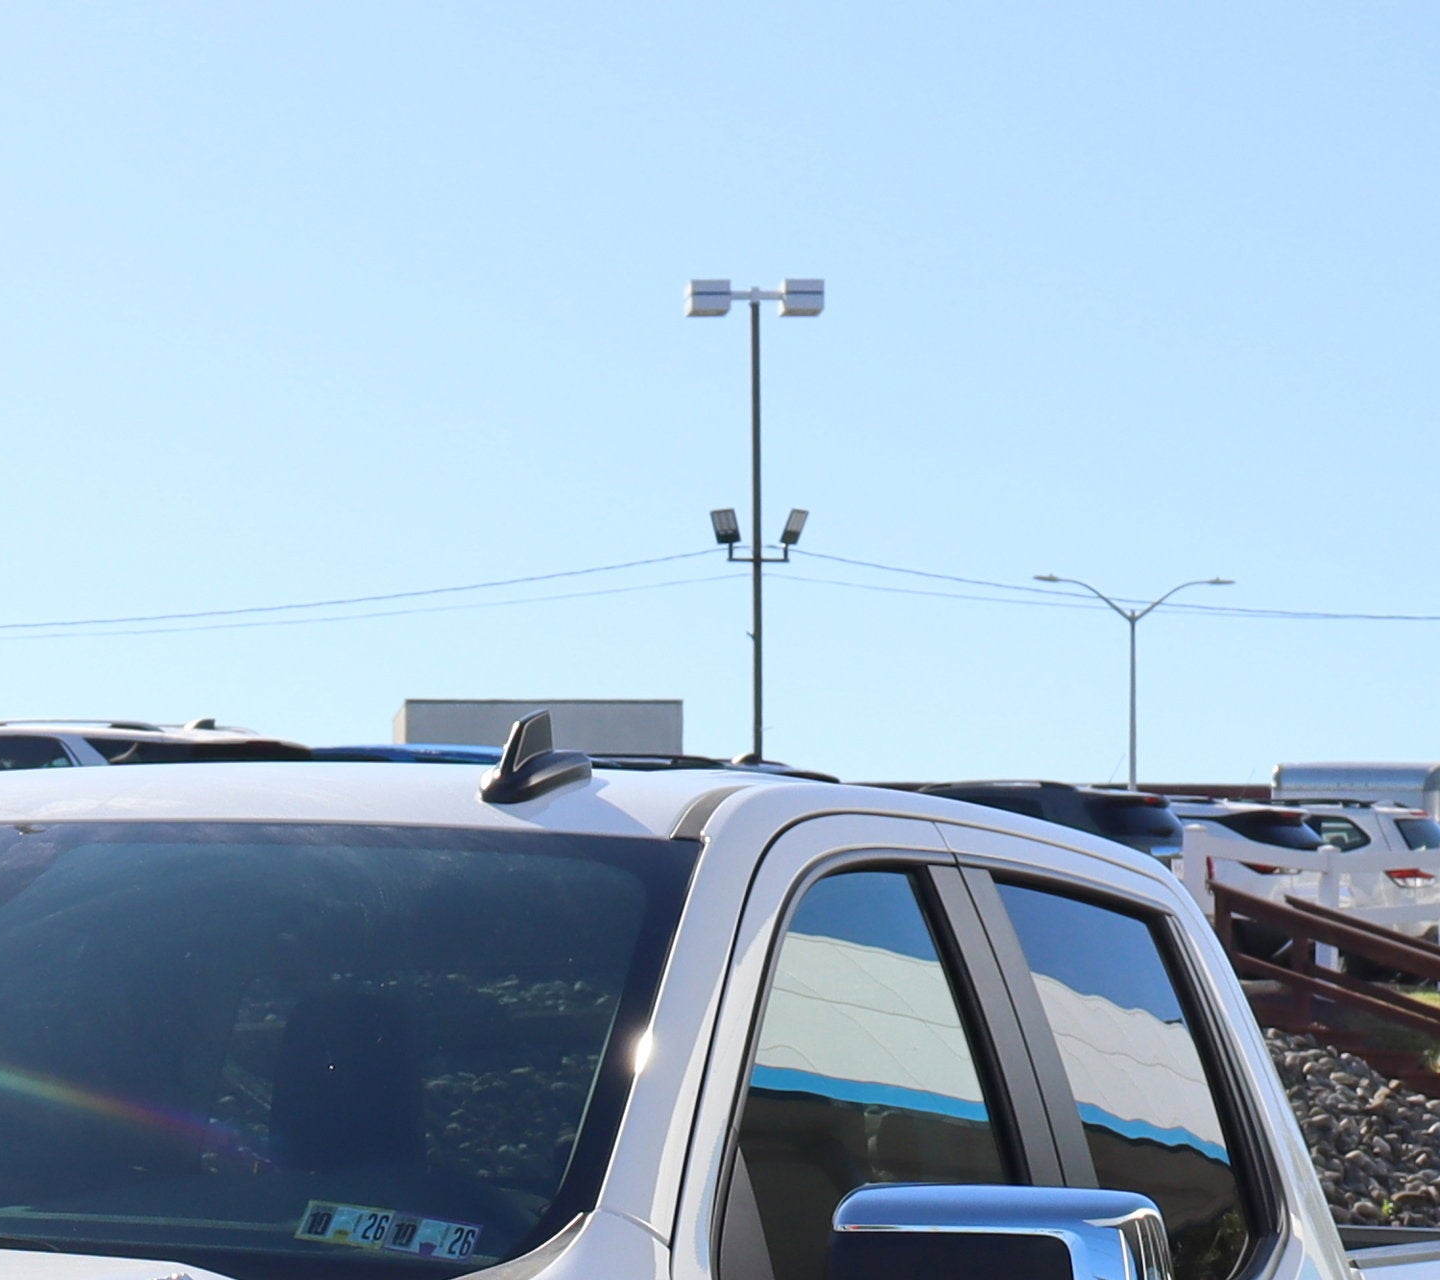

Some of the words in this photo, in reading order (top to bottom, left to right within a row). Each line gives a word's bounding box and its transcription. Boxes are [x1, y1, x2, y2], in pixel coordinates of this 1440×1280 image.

[307, 1211, 332, 1235] 10
[360, 1213, 390, 1241] 26
[391, 1221, 418, 1248] 10
[447, 1227, 476, 1257] 26
